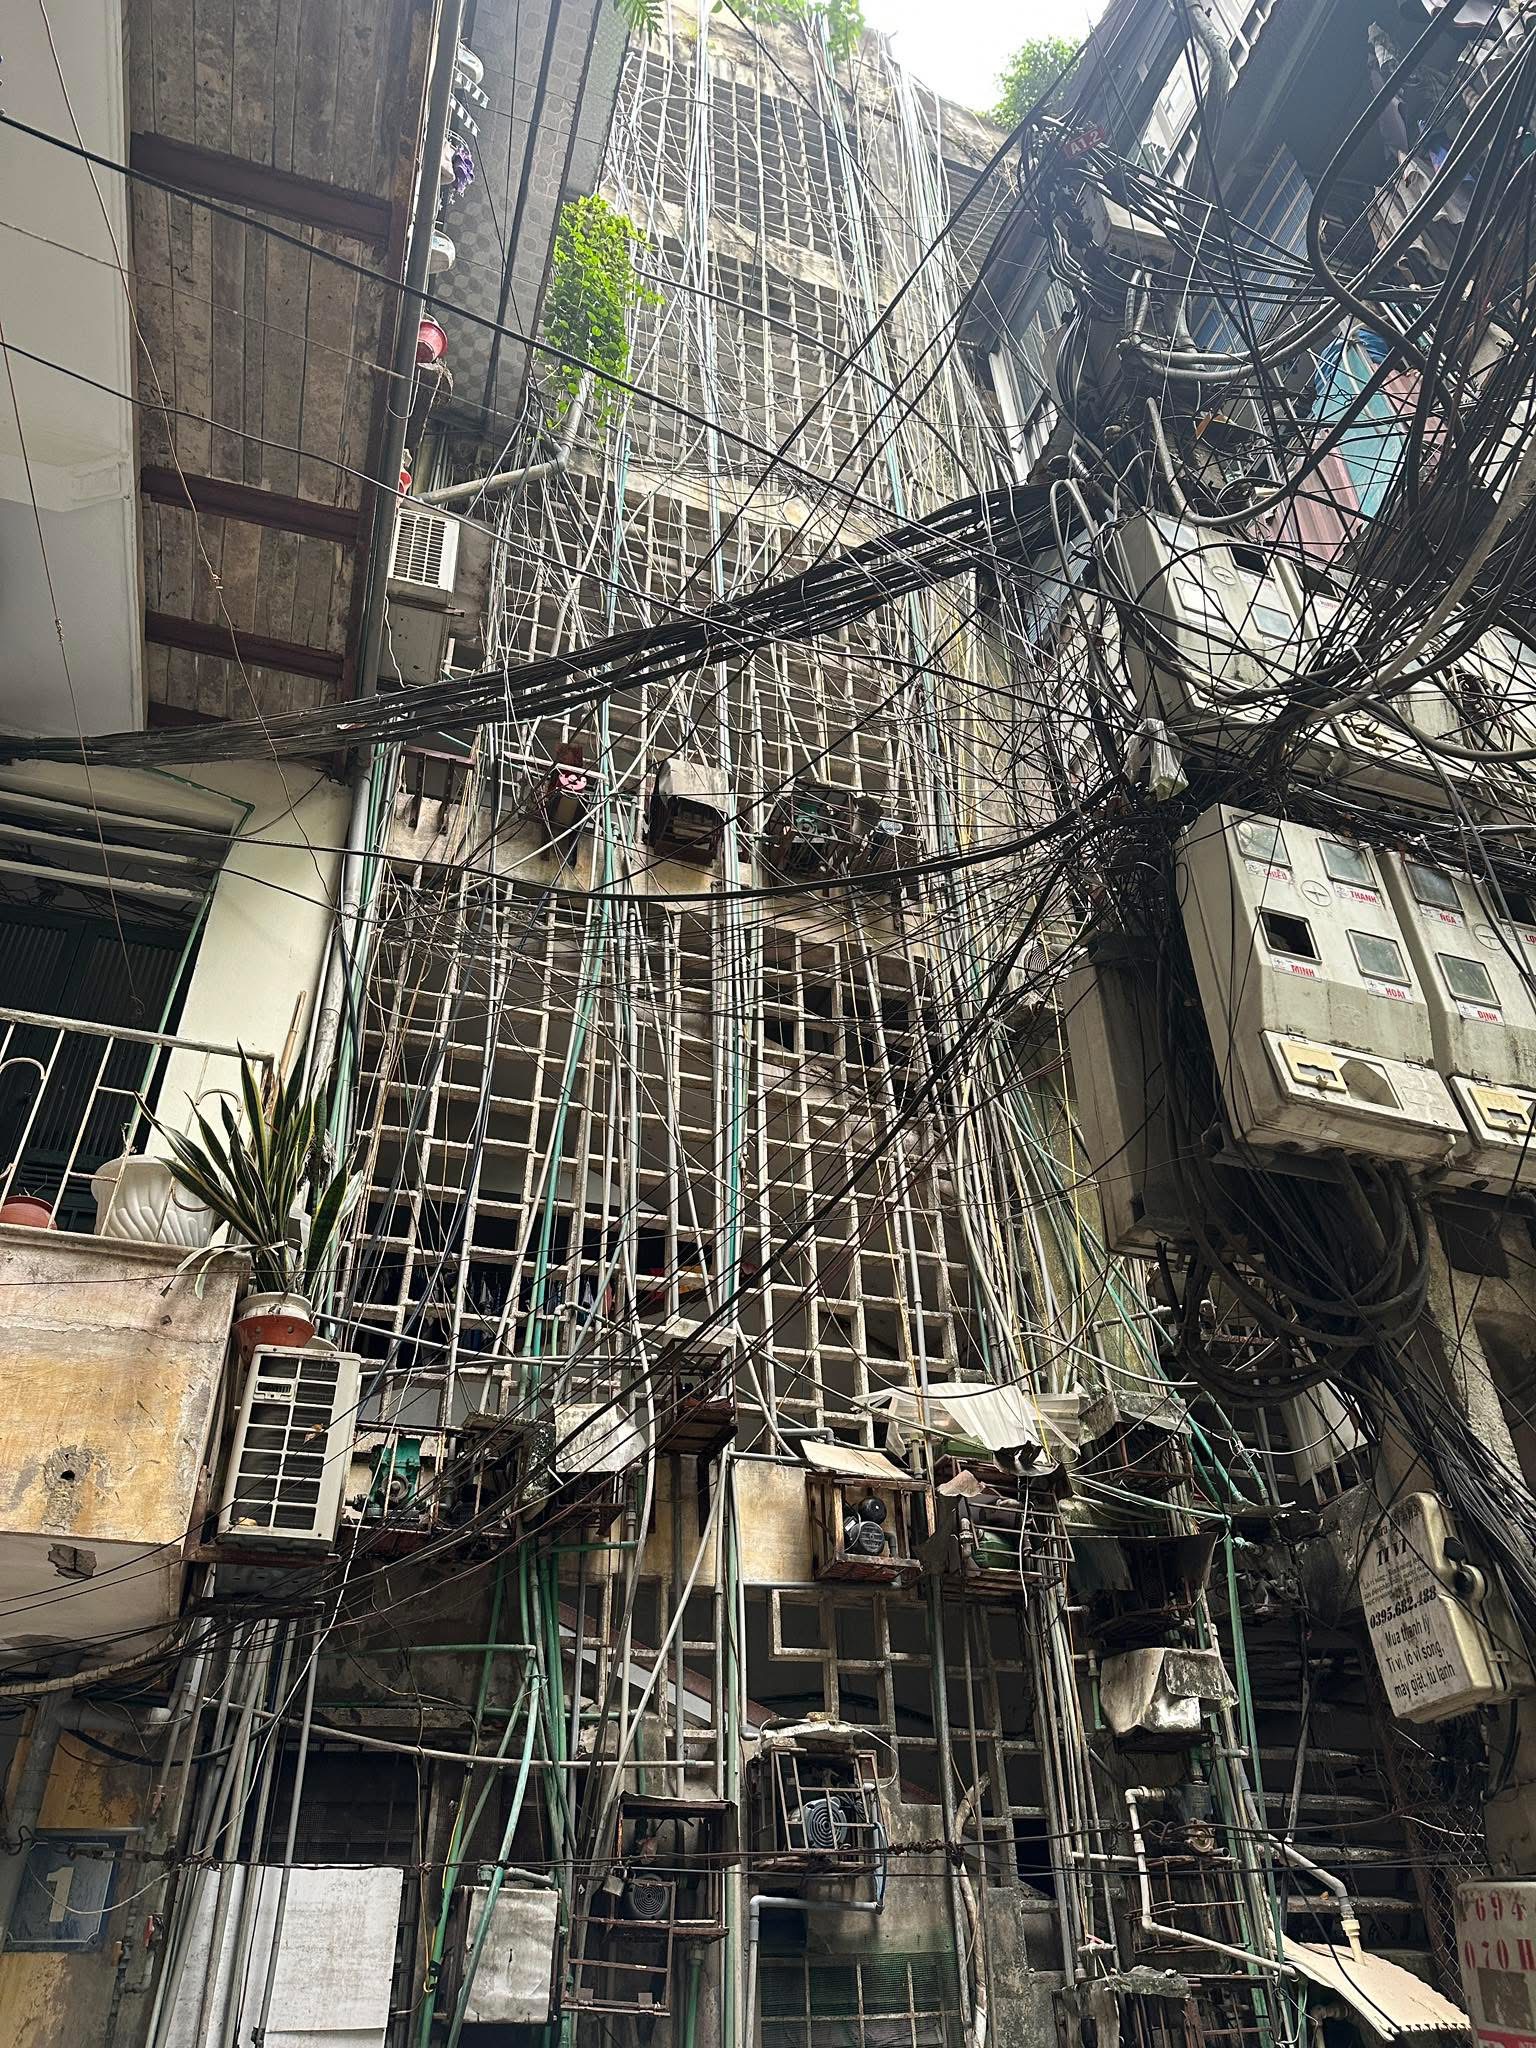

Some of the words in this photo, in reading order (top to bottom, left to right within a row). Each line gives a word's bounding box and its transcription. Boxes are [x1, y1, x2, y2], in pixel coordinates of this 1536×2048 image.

[1290, 963, 1315, 978] MINH
[1369, 1585, 1437, 1629] 0395.682.488
[1384, 1630, 1402, 1649] Mua
[1400, 1618, 1423, 1641] thanh
[1421, 1640, 1445, 1660] sóng,
[1394, 1679, 1412, 1699] máy
[1435, 1660, 1456, 1685] lạnh
[45, 1866, 74, 1923] 1
